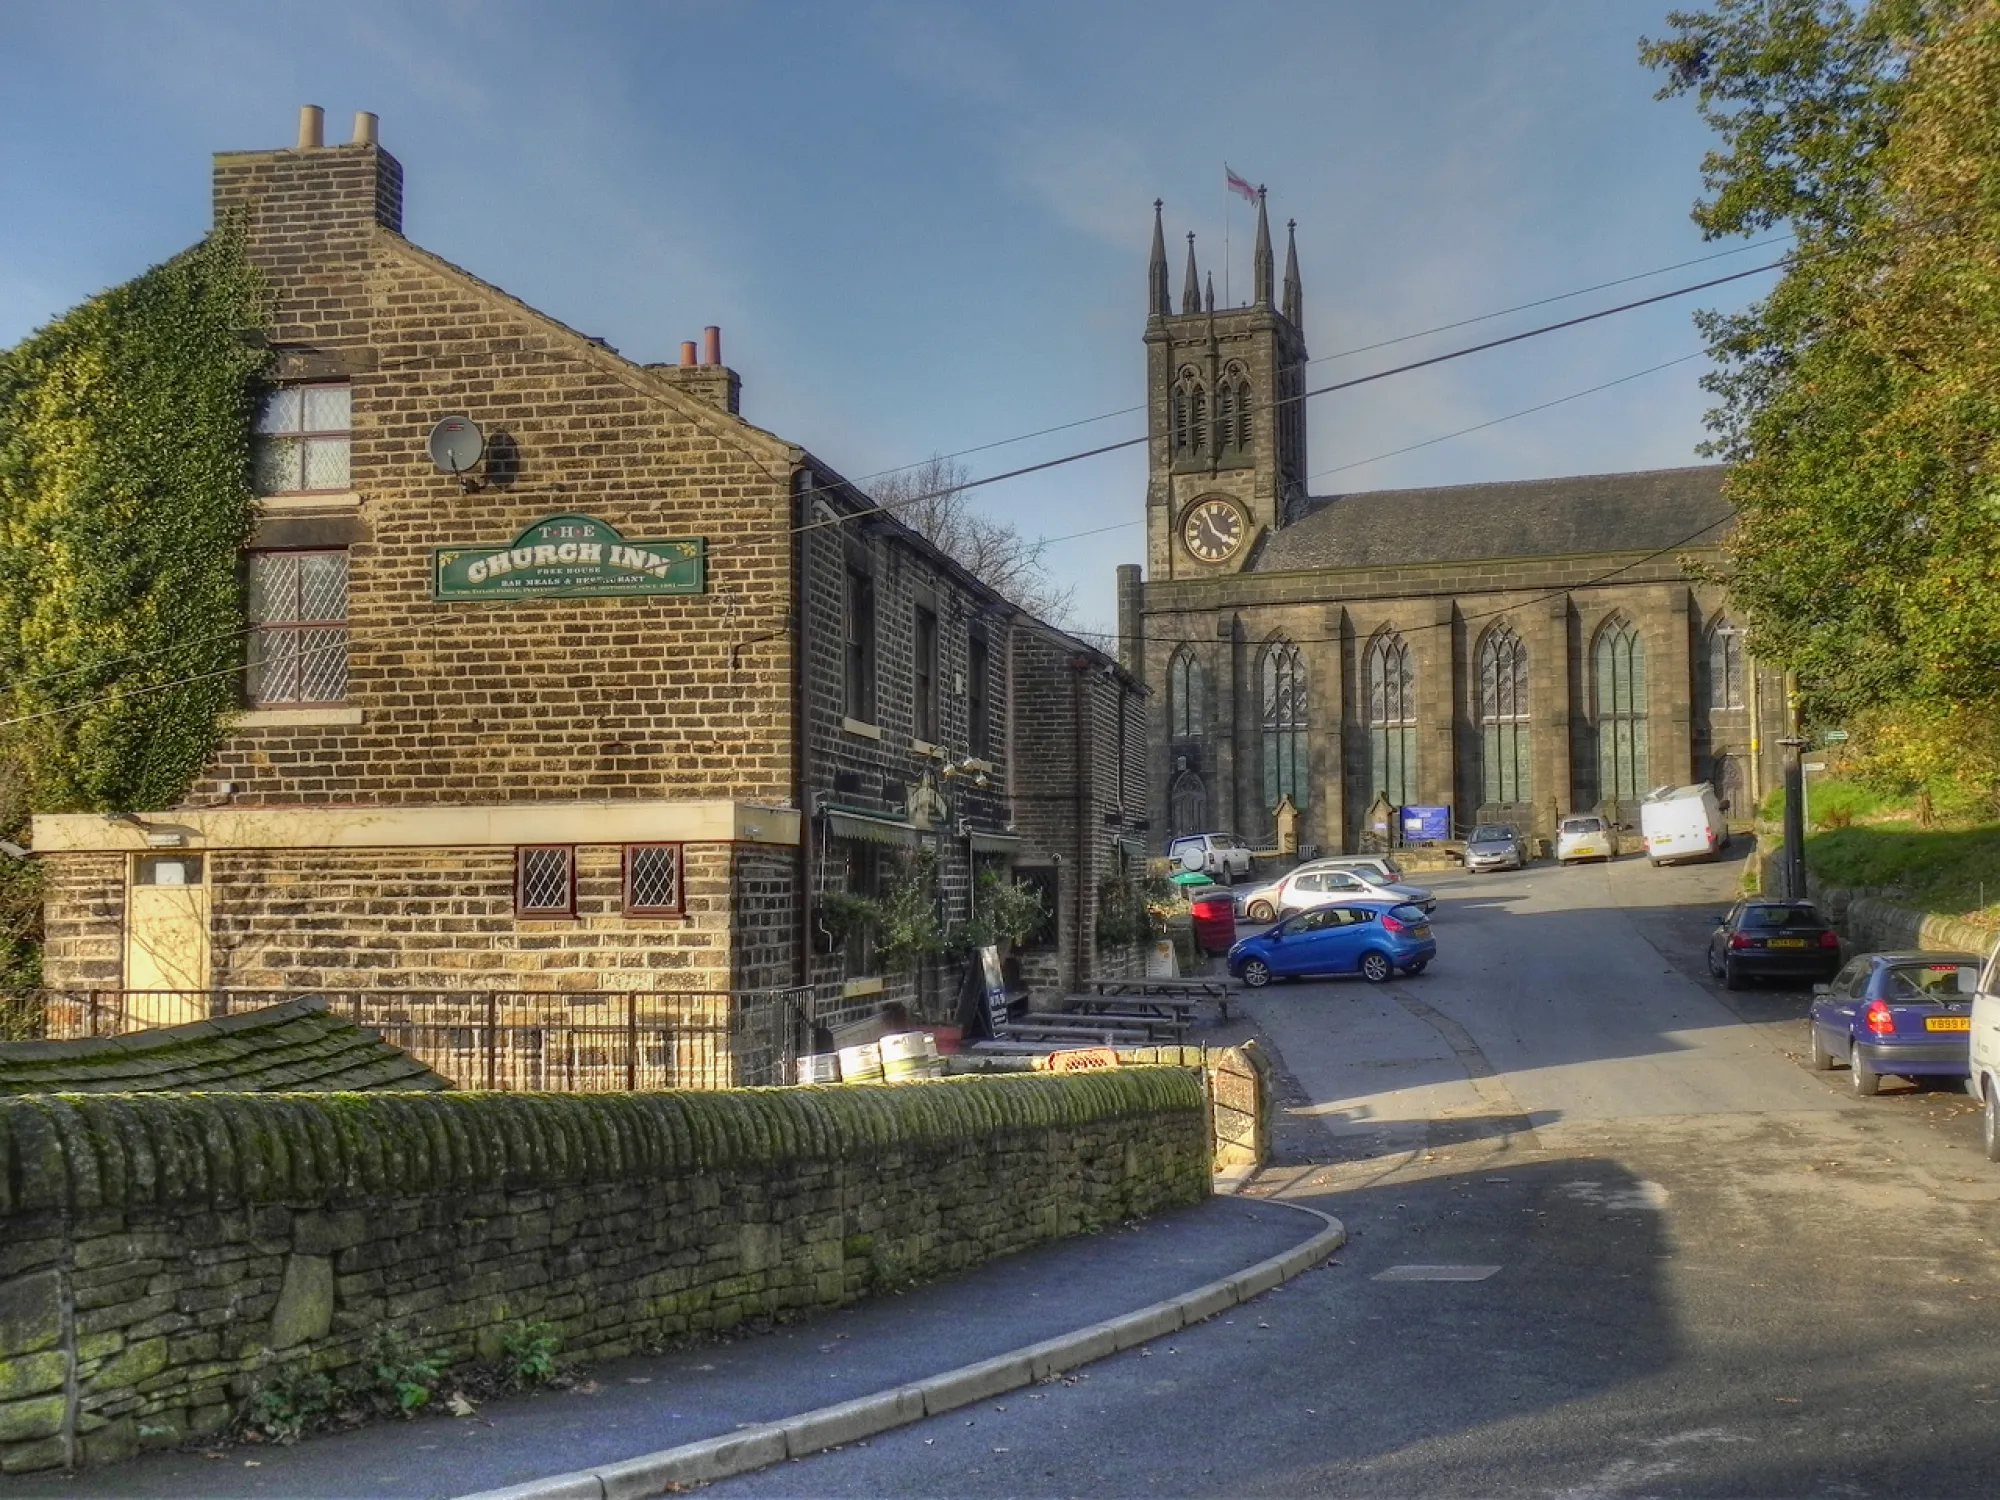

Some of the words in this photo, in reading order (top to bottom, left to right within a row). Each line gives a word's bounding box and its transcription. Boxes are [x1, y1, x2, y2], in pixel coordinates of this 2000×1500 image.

[467, 543, 603, 583] CHURCH
[608, 545, 671, 579] INN
[566, 566, 601, 574] HOUSE
[501, 579, 522, 587] BAR
[526, 577, 560, 586] MEALS
